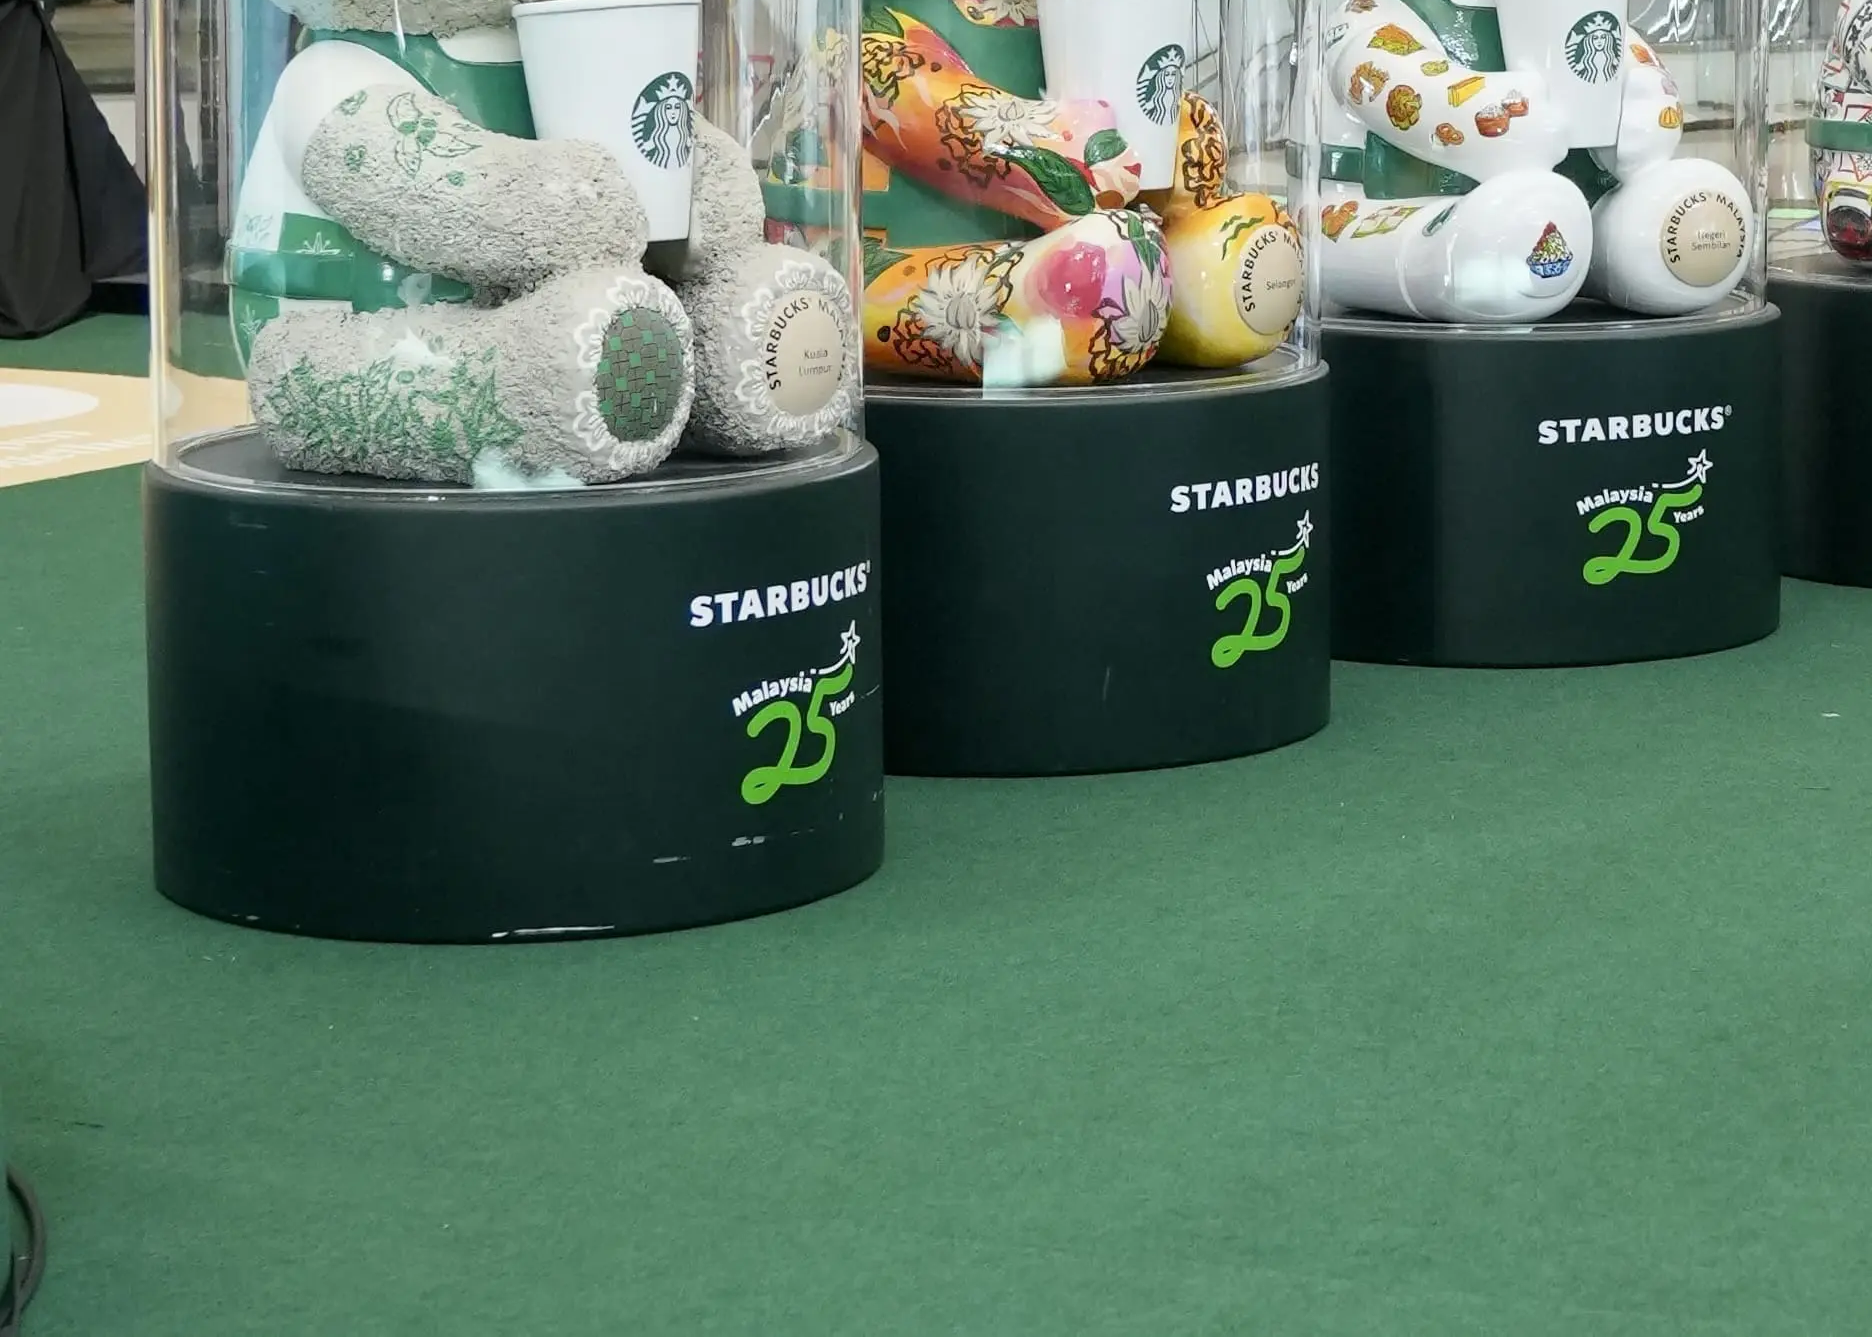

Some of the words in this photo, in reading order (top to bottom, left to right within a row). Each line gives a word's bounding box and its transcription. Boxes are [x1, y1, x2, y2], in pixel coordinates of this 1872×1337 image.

[1667, 192, 1707, 264] STARBUCKS
[1241, 231, 1277, 312] STARBUCKS
[766, 297, 809, 391] STARBUCKS
[1538, 406, 1726, 445] STARBUCKS
[1170, 462, 1319, 513] STARBUCKS
[1576, 485, 1654, 516] Malaysia
[1583, 483, 1703, 586] 25
[1673, 505, 1704, 524] Years
[690, 562, 868, 628] STARBUCKS
[1206, 554, 1273, 591] Malaysia
[1211, 545, 1305, 668] 25
[1286, 572, 1308, 594] Years
[732, 672, 813, 717] Malaysia
[741, 663, 853, 805] 25
[829, 690, 856, 717] Years
